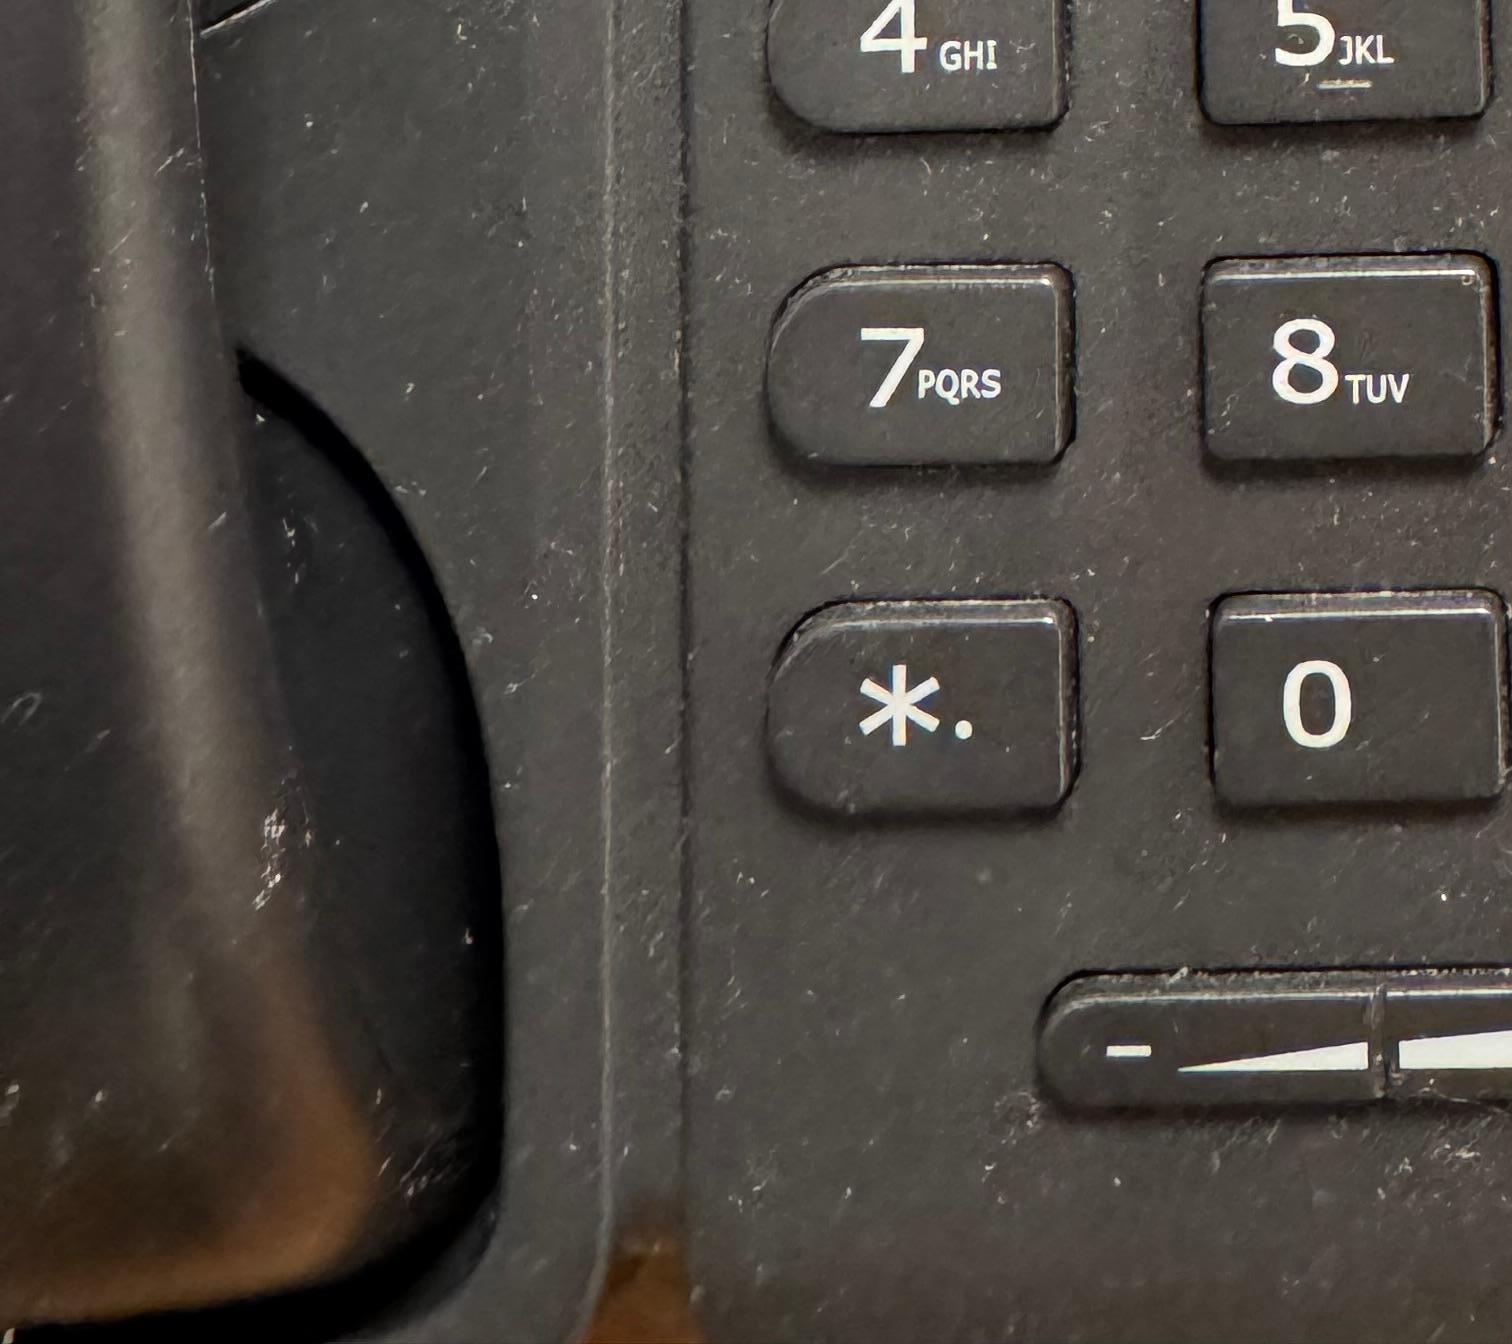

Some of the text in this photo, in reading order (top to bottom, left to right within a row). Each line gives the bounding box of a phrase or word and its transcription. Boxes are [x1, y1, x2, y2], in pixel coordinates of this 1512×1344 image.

[939, 39, 998, 71] GHI
[1338, 35, 1395, 66] JKL
[860, 328, 1002, 408] 7 PQRS
[1272, 319, 1410, 405] 8 TUV
[1283, 660, 1352, 747] 0
